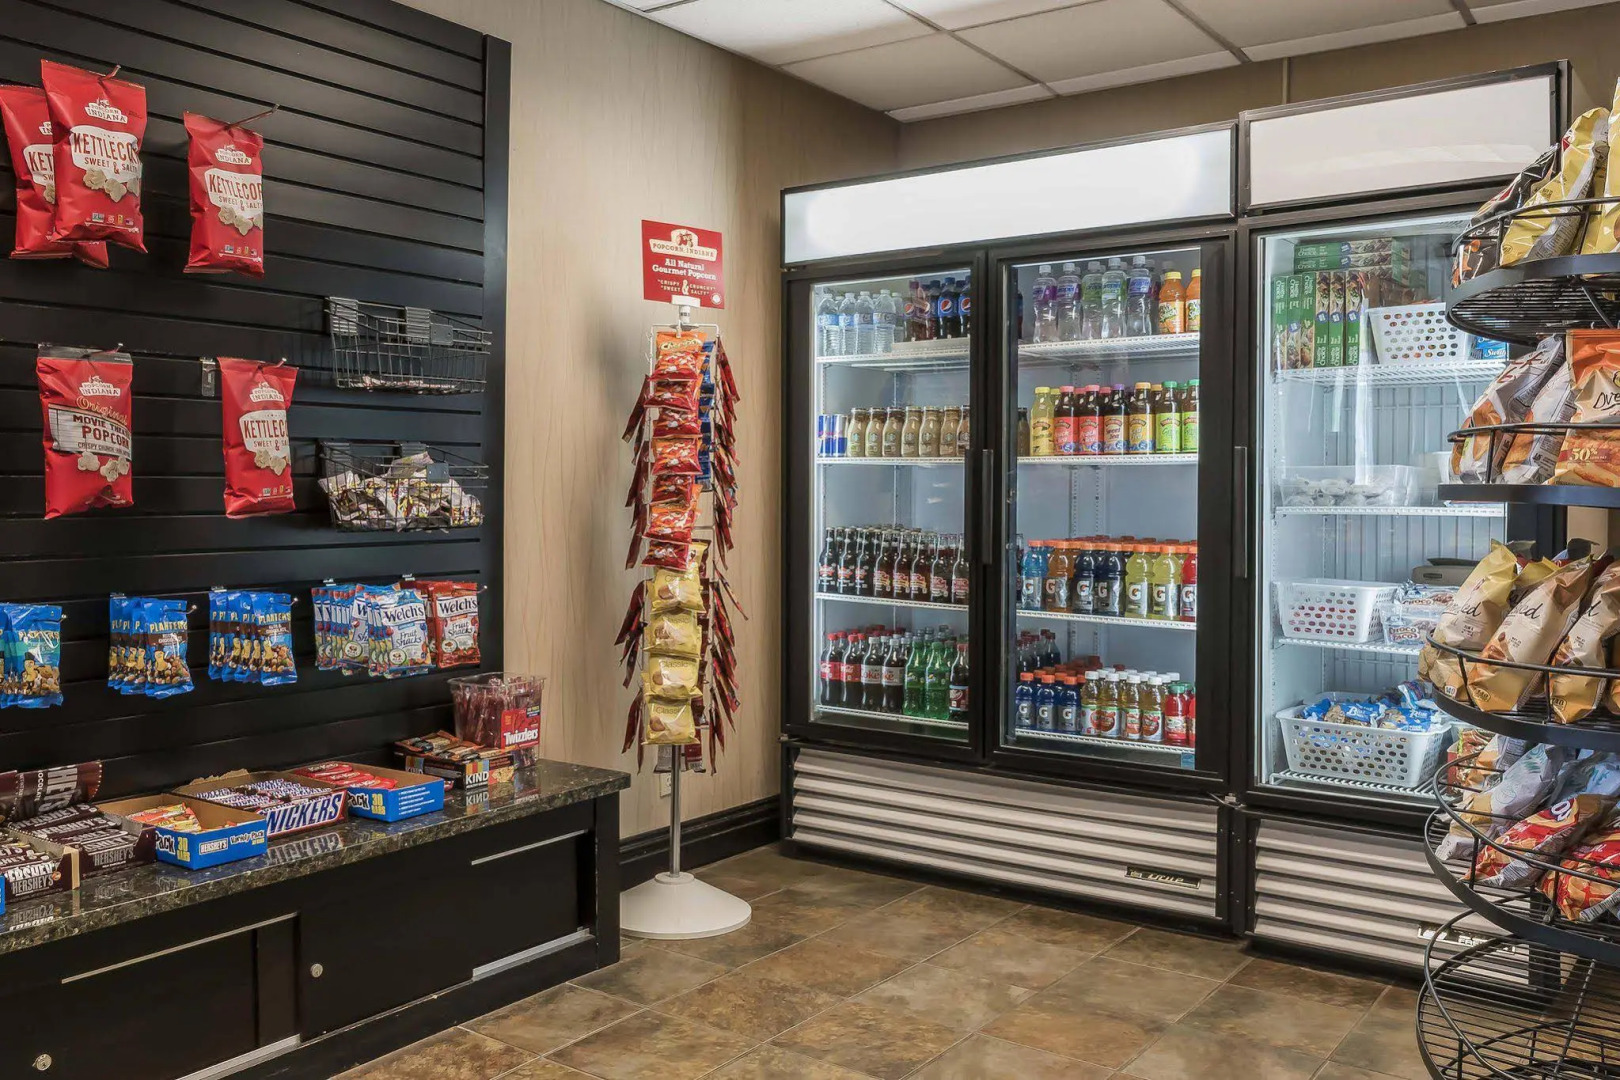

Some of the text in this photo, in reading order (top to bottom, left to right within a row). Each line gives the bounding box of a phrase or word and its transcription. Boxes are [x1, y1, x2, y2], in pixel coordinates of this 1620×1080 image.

[87, 107, 127, 122] INDIANA
[84, 157, 110, 168] SWEET
[113, 161, 120, 175] &
[218, 196, 238, 206] SWEET
[652, 243, 714, 258] POPCORN INDIANA
[652, 264, 716, 280] Gourmet Popcorn
[665, 258, 705, 271] All Natural
[81, 387, 119, 396] INDIANA
[76, 396, 128, 426] Original
[72, 414, 107, 429] MOVIE
[82, 425, 130, 448] POPCORN
[253, 440, 273, 448] SWEET
[77, 441, 98, 450] CRISPY
[1569, 447, 1598, 461] 50%
[1129, 584, 1142, 601] G
[384, 605, 424, 622] Welch's
[439, 598, 479, 614] Welch's
[448, 628, 473, 637] Snacks
[452, 622, 469, 630] Fruit
[400, 630, 417, 639] Fruit
[396, 637, 422, 648] Snacks
[1018, 703, 1028, 714] G
[1039, 707, 1048, 718] G
[1062, 708, 1072, 720] G
[504, 728, 538, 746] Twizzlers
[465, 771, 489, 785] KIND
[267, 794, 342, 834] NICKERS
[177, 836, 189, 852] 30
[200, 838, 228, 855] HERSHEY'S
[251, 829, 265, 840] Pack
[94, 848, 136, 867] HERSHEY'S
[12, 874, 54, 895] HERSHEY'S
